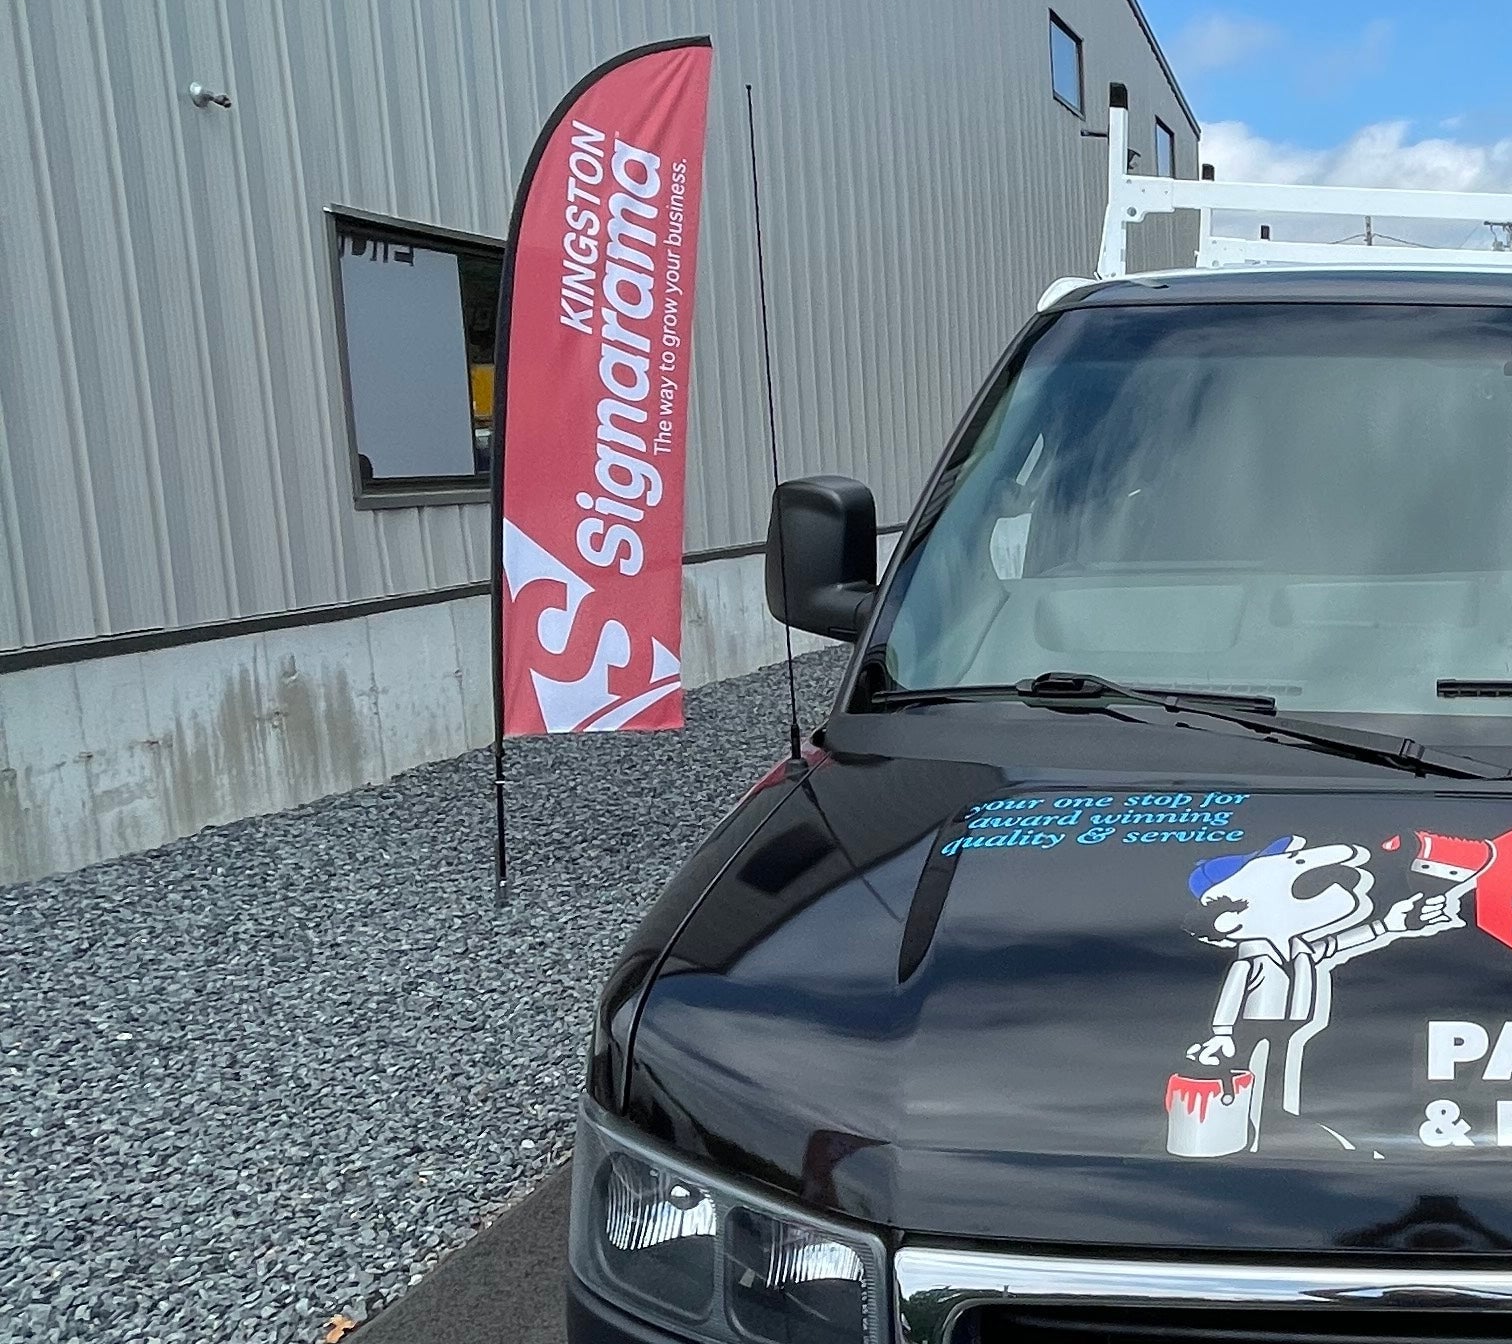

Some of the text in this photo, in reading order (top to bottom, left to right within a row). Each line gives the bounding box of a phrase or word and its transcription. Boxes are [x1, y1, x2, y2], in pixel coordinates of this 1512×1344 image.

[560, 120, 606, 335] KINGSTON
[653, 158, 687, 456] The way to grow your business.
[576, 138, 662, 576] Signarama
[968, 808, 1234, 829] award winning
[1053, 795, 1117, 808] one
[1123, 792, 1193, 809] stop
[1199, 791, 1250, 808] for
[941, 826, 1245, 857] quality & service
[1418, 1098, 1475, 1148] &
